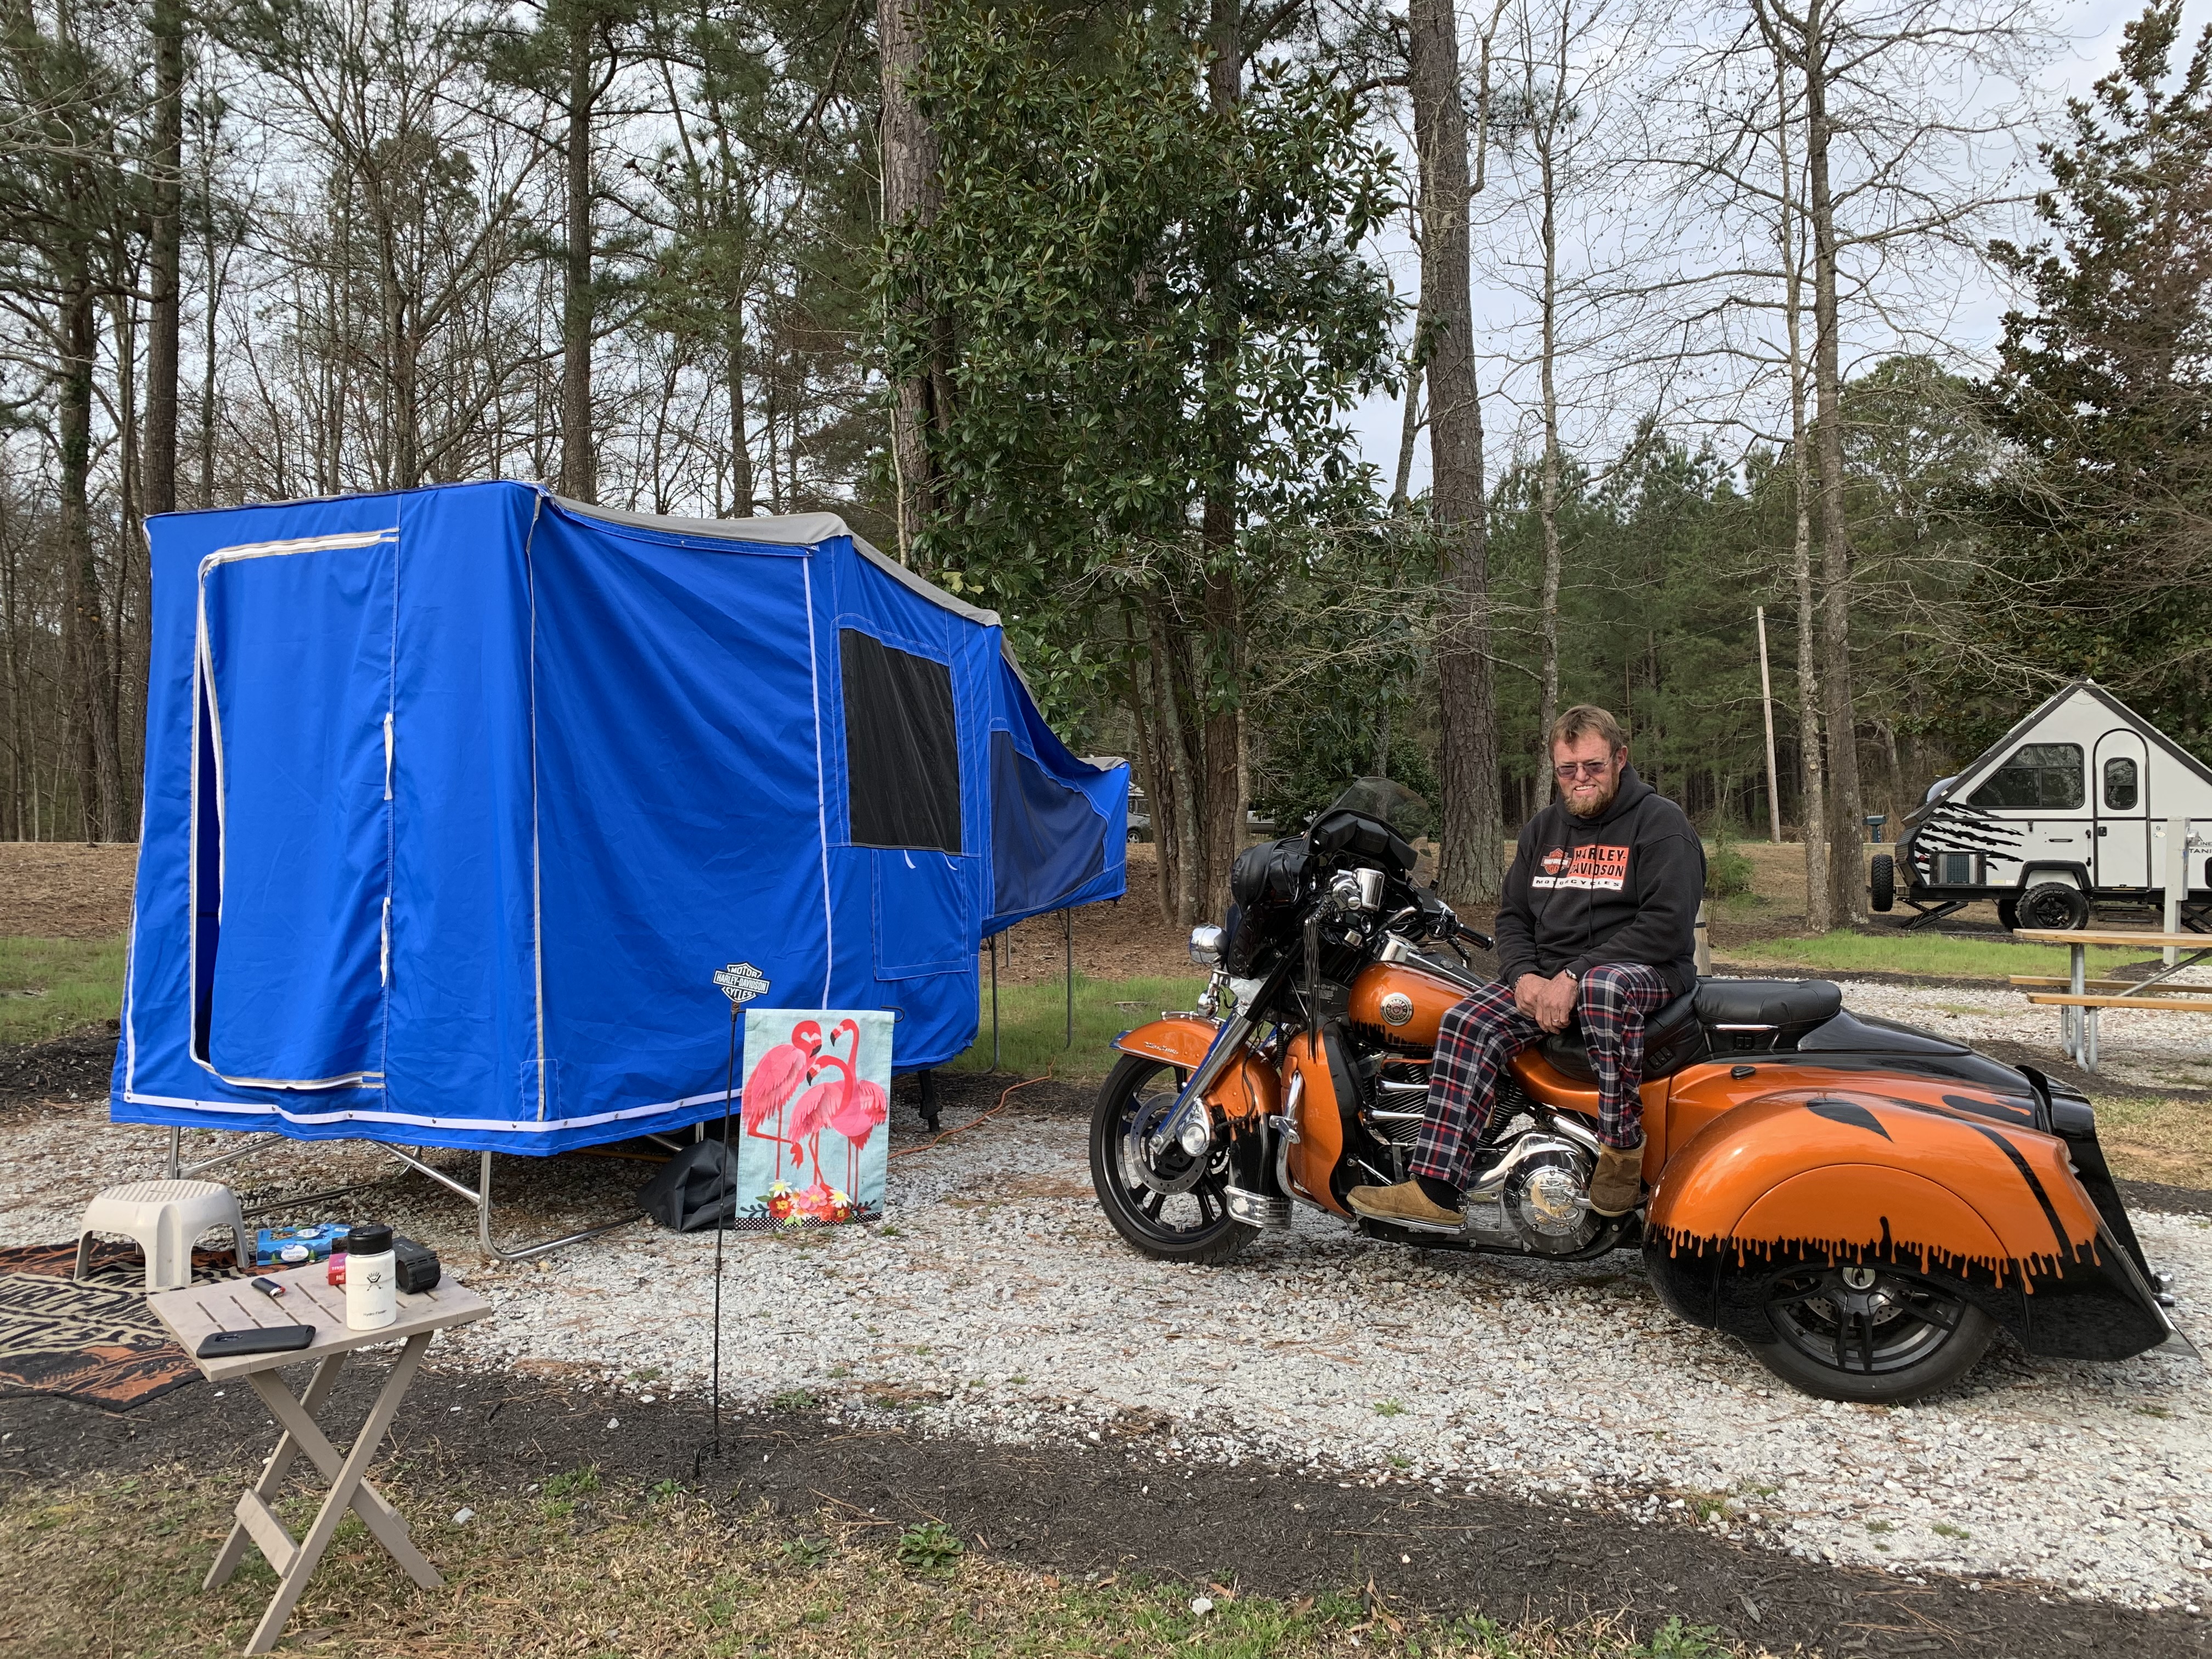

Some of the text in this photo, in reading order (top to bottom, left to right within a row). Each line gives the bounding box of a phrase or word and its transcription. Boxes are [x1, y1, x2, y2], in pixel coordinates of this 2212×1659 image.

[730, 966, 758, 978] MOTOR
[716, 973, 767, 992] HARLEY-DAVIDSON
[726, 986, 752, 1001] CYCLES
